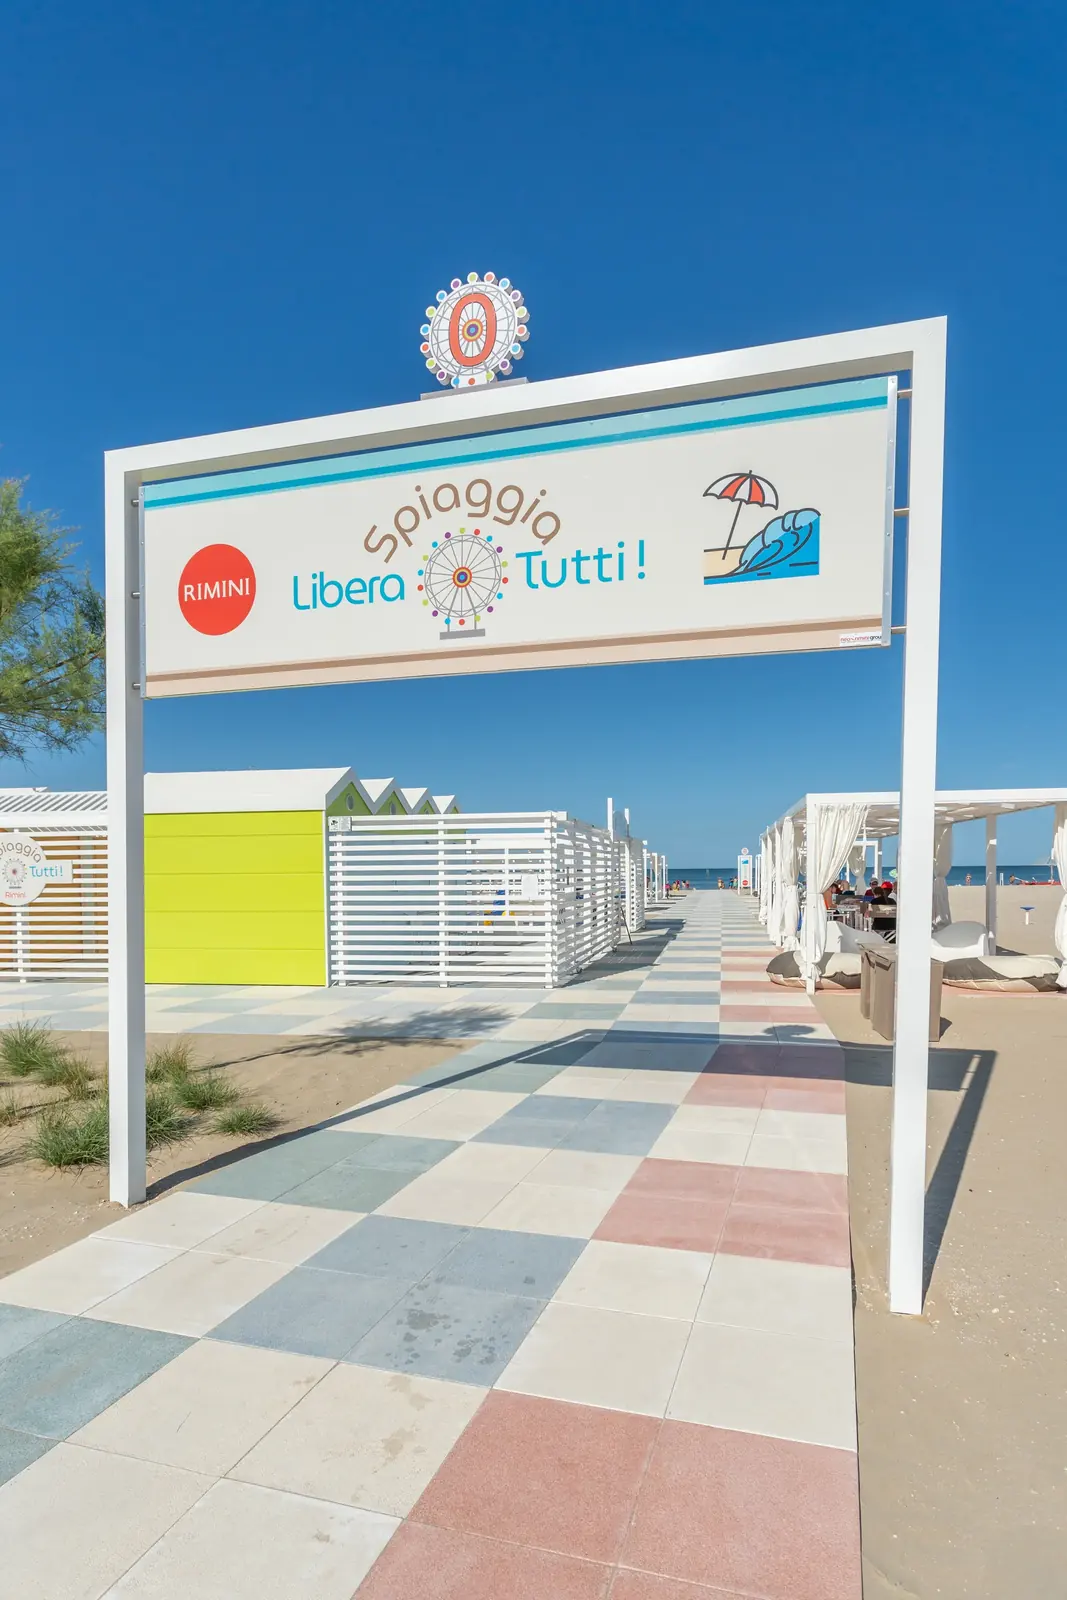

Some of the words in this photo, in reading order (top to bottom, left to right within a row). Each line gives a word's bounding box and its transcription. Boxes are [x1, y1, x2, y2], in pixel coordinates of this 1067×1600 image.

[363, 478, 561, 564] Spiaggia
[182, 575, 251, 603] RIMINI
[292, 570, 406, 611] Libera
